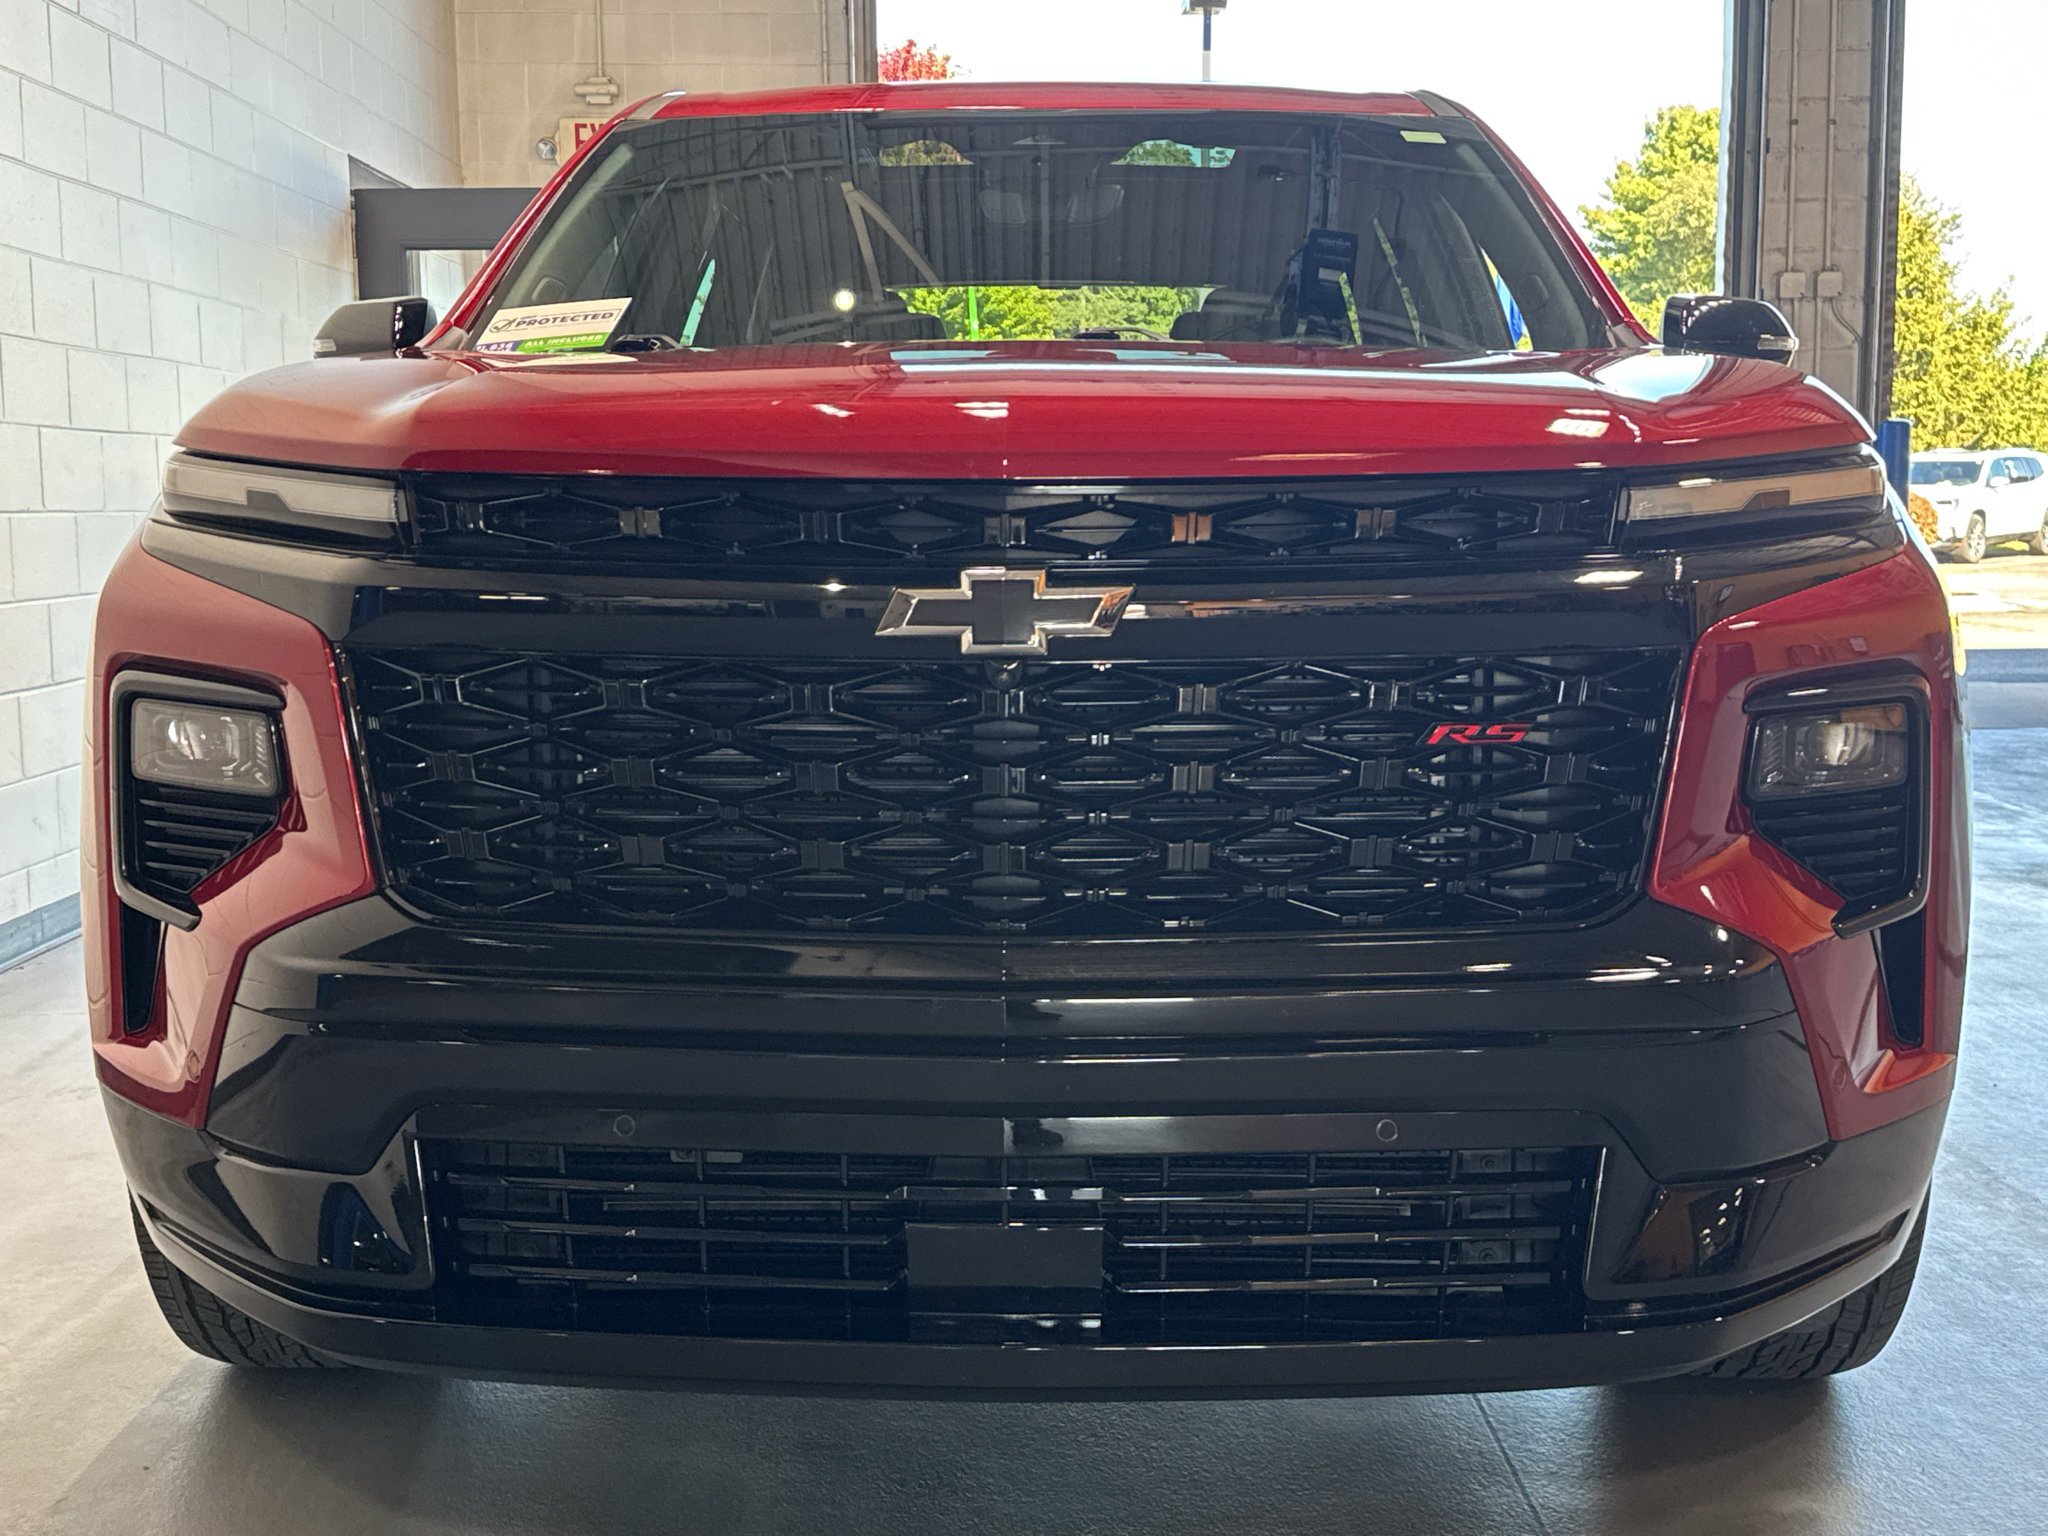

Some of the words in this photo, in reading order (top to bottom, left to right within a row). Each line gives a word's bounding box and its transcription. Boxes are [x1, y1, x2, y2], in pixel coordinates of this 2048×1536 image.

[515, 312, 614, 328] PROTECTED
[524, 340, 544, 348] ALL
[547, 334, 604, 345] INCLUDED
[1427, 723, 1532, 744] RS
